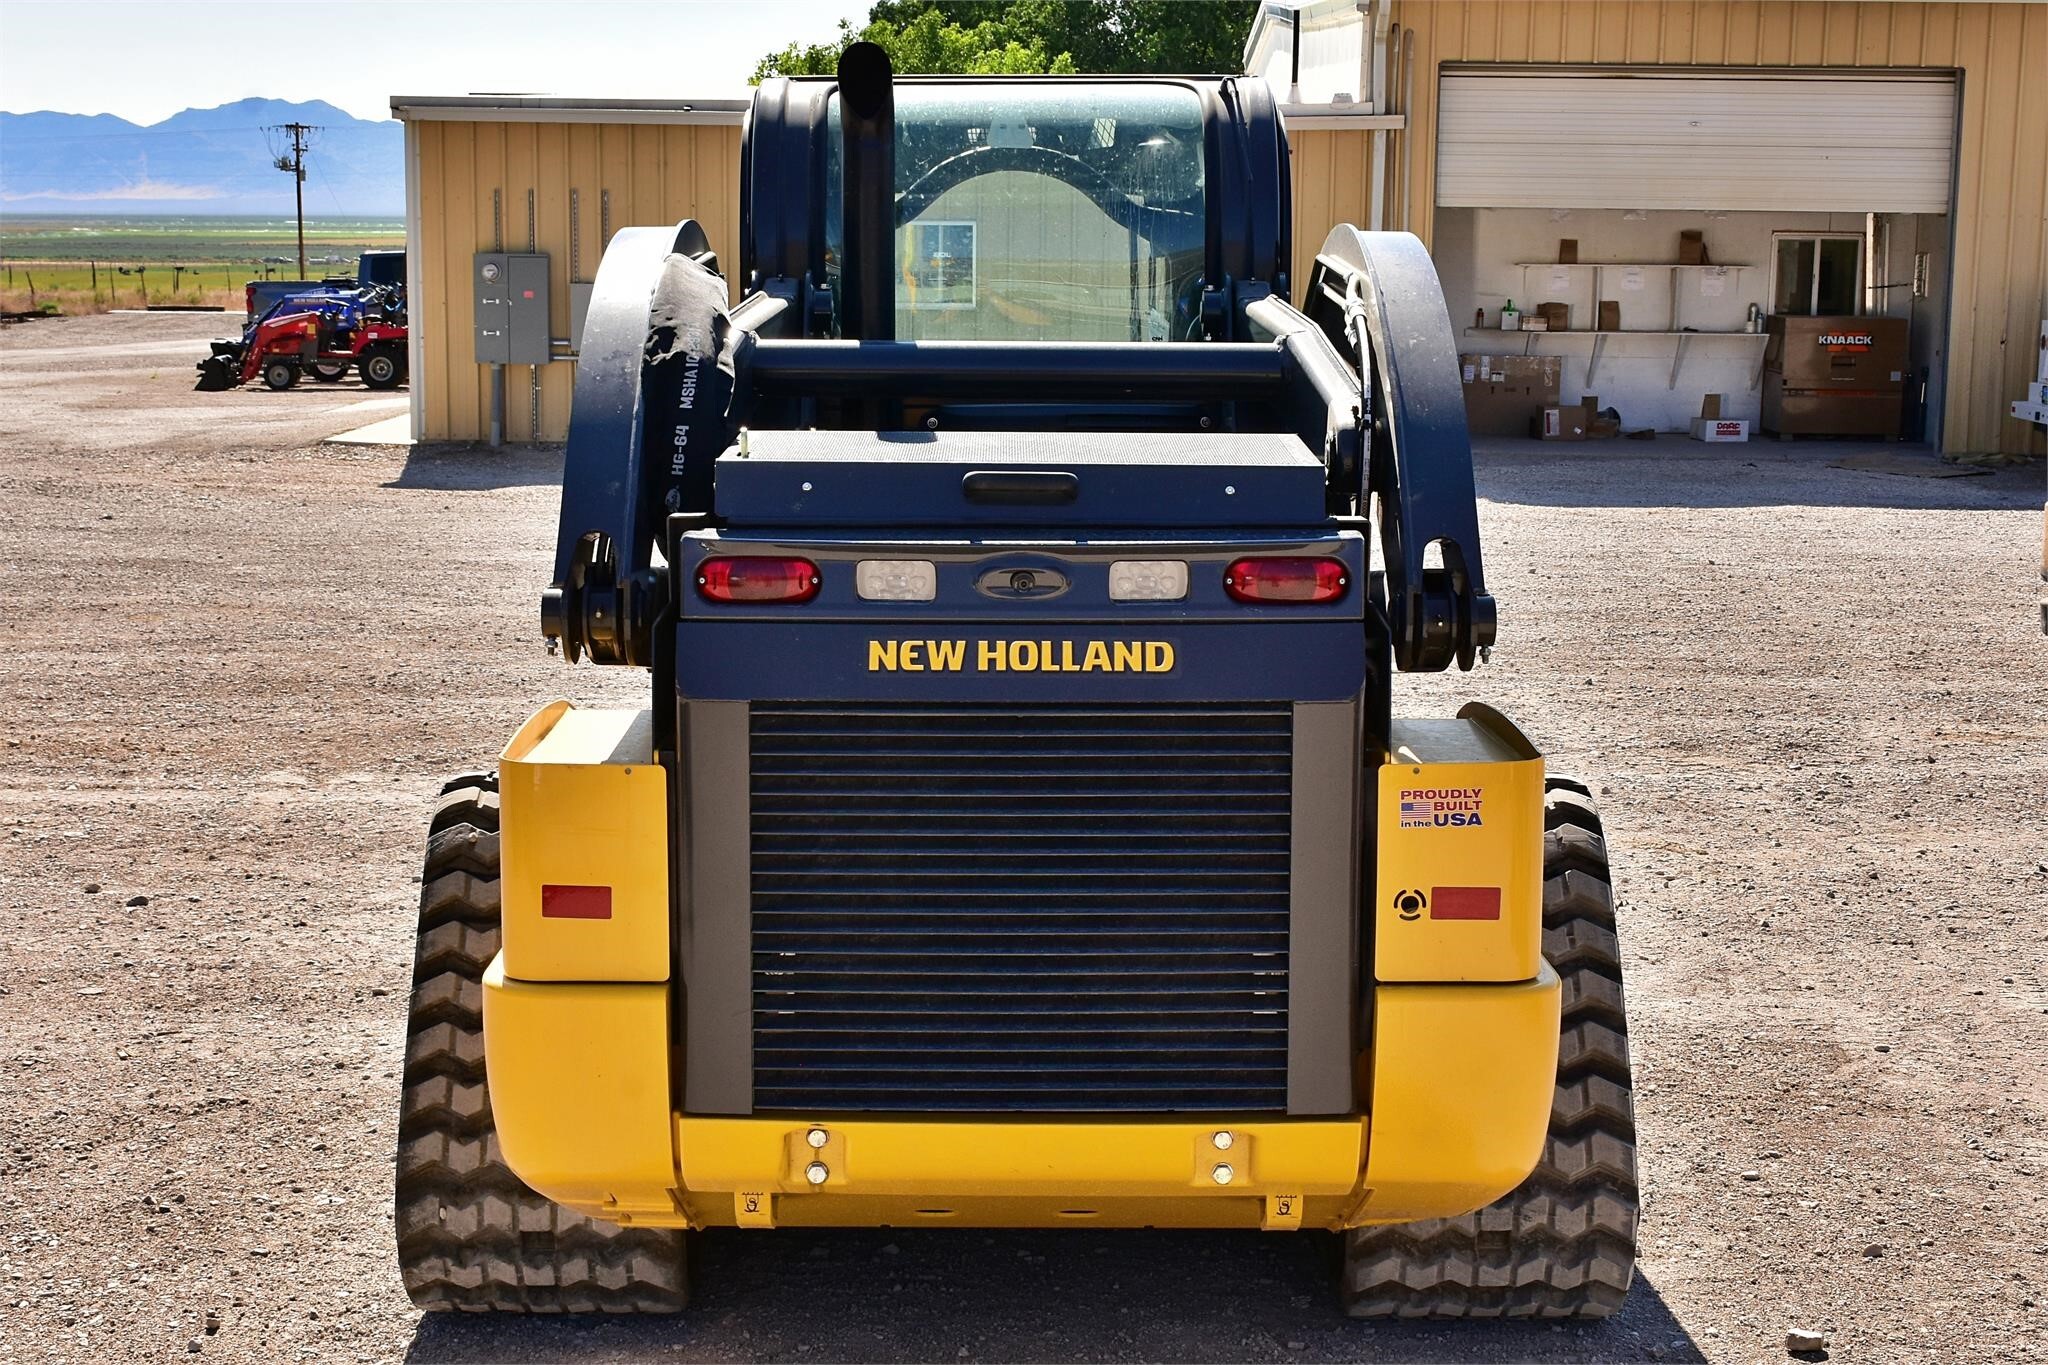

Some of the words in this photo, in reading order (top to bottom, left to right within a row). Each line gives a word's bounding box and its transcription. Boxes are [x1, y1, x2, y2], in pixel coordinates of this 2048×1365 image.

[1818, 335, 1872, 345] KNAACK
[679, 369, 699, 409] MSHA
[671, 425, 690, 476] HG-64
[868, 640, 966, 671] NEW
[977, 640, 1175, 673] HOLLAND
[1400, 788, 1482, 800] PROUDLY
[1433, 800, 1483, 812] BUILT
[1400, 820, 1411, 828] in
[1413, 820, 1432, 828] the
[1433, 812, 1483, 827] USA
